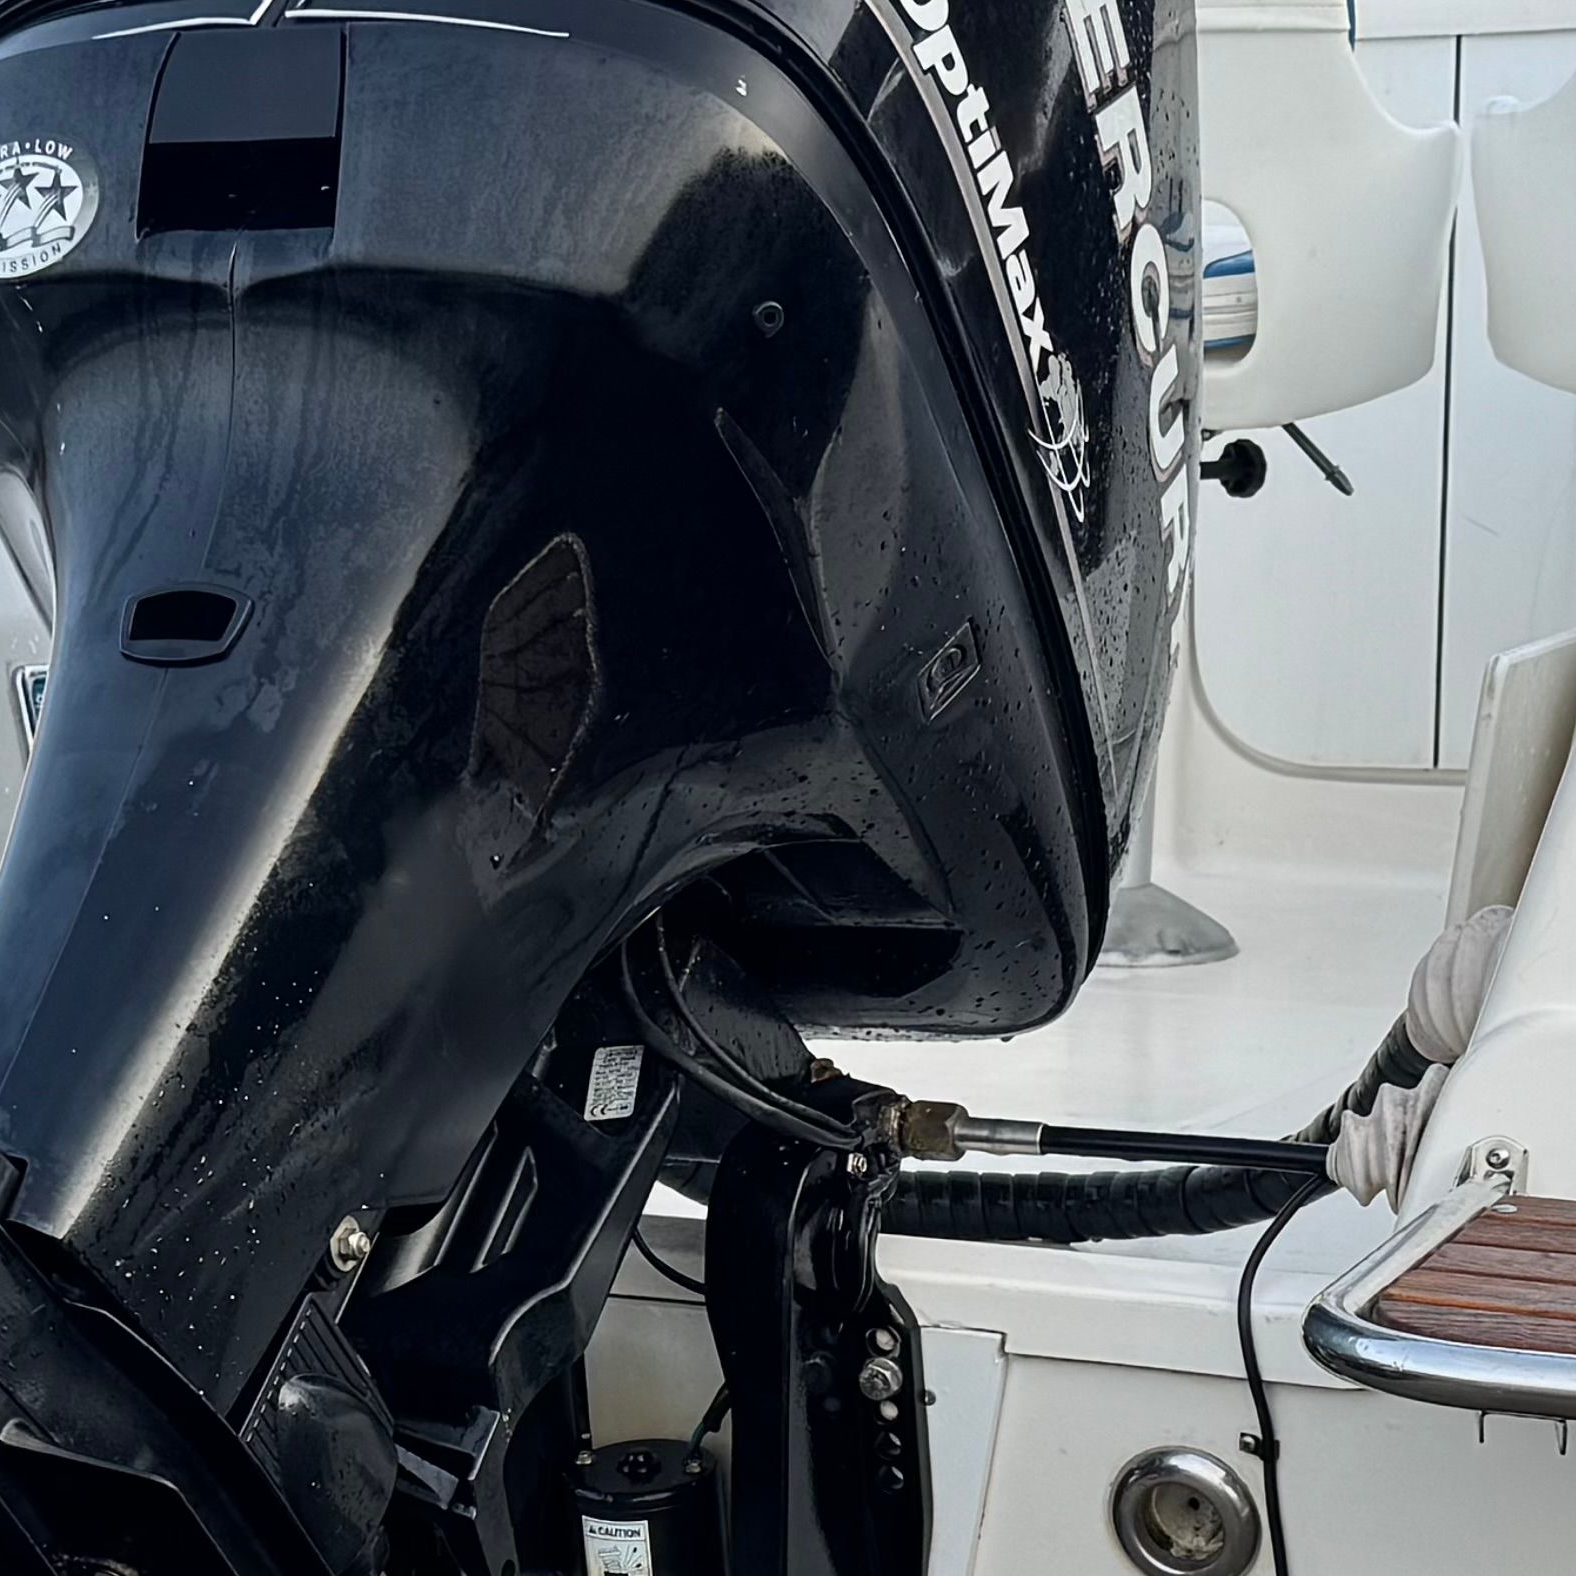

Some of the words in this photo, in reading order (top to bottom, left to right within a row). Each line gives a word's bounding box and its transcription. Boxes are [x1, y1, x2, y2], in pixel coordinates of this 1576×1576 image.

[35, 139, 73, 161] LOW
[1065, 0, 1191, 664] ERCUR
[597, 1525, 641, 1539] CAUTION
